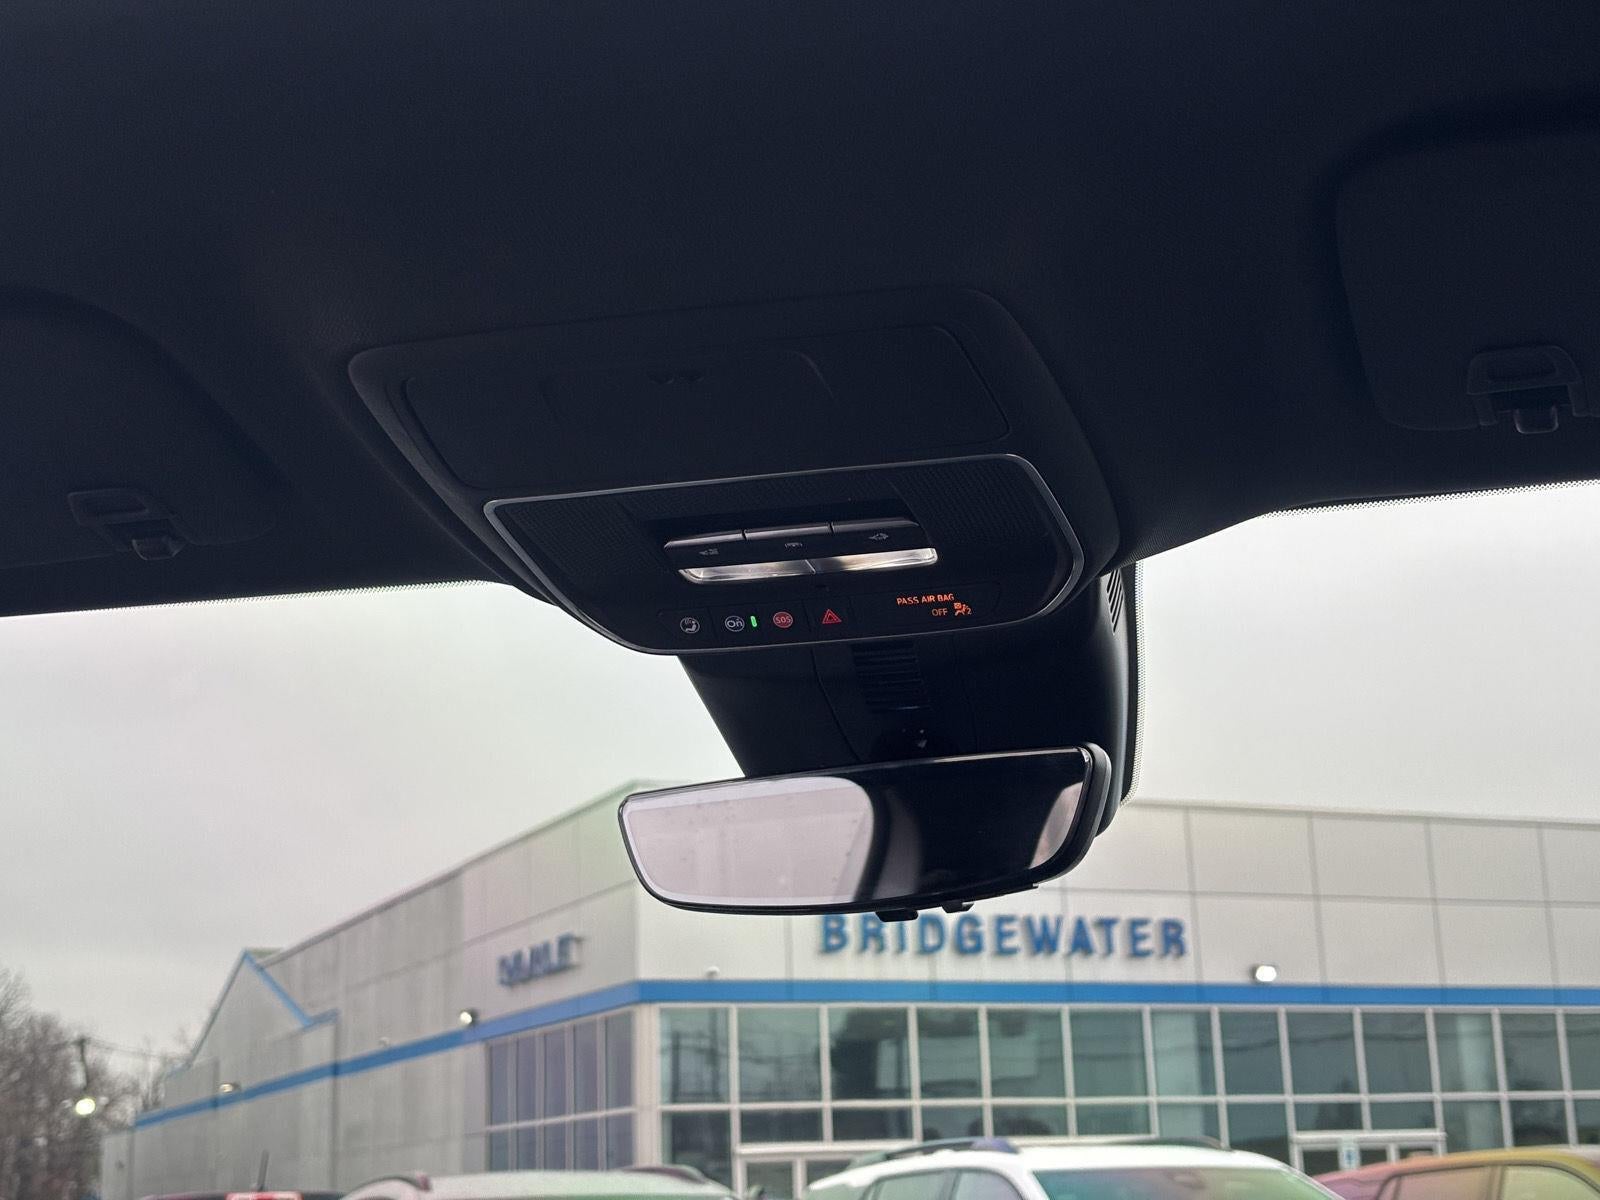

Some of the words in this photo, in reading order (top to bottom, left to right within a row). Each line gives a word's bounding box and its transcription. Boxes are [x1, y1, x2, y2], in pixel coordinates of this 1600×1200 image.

[896, 597, 919, 605] PASS
[921, 595, 935, 604] AIR
[937, 593, 955, 602] BAG
[931, 608, 948, 616] OFF
[775, 614, 791, 625] SOS
[821, 912, 1189, 958] BRIDGEWATER
